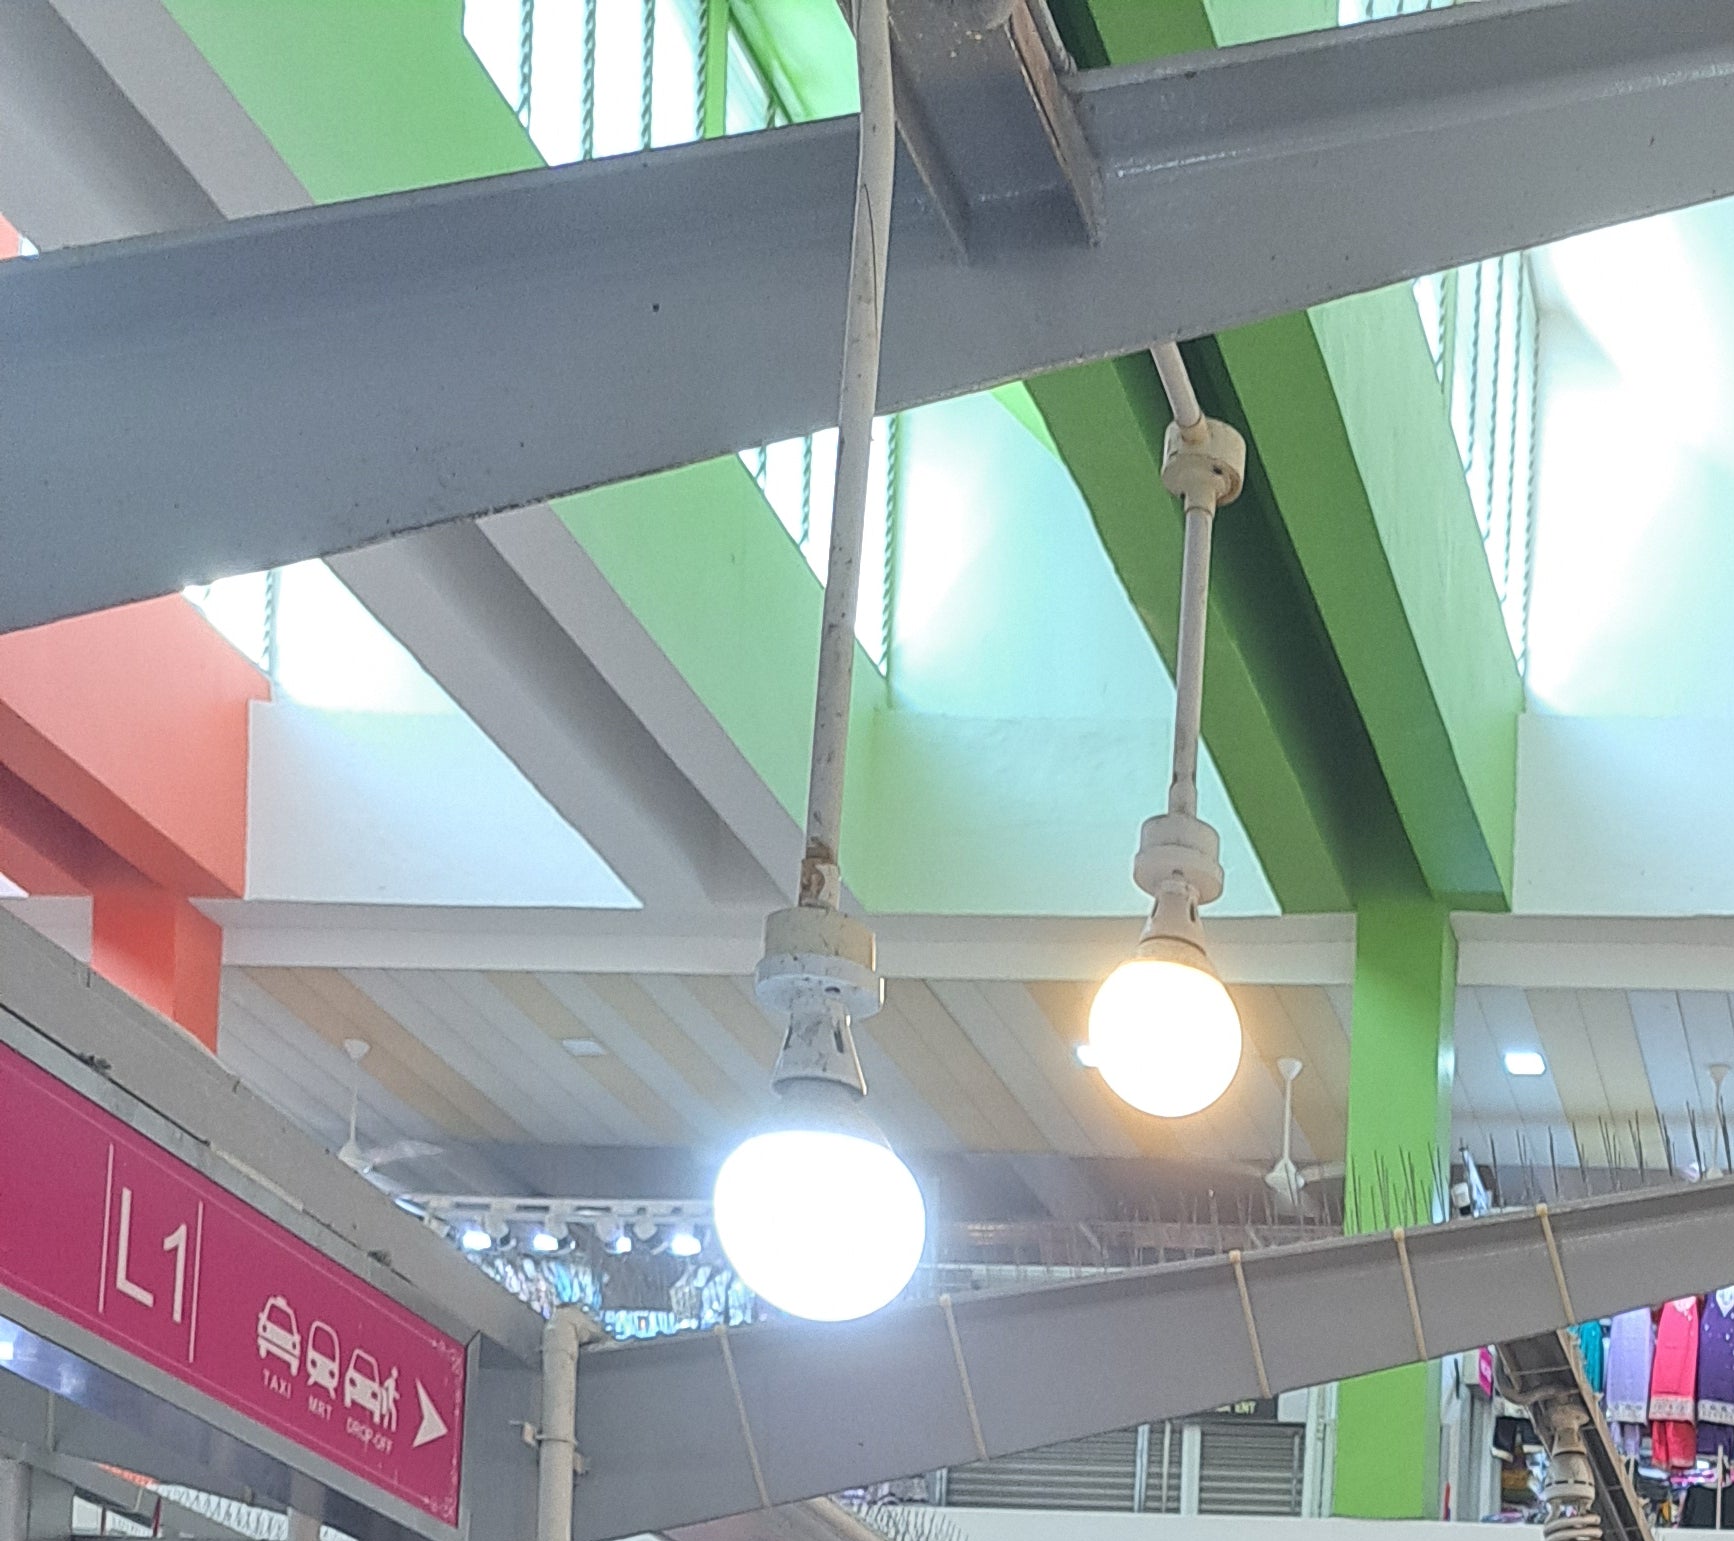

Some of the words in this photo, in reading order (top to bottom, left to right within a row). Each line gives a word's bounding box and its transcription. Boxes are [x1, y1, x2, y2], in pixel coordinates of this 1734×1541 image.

[115, 1186, 188, 1325] L1
[263, 1368, 292, 1399] TAXI
[308, 1394, 333, 1421] MRT
